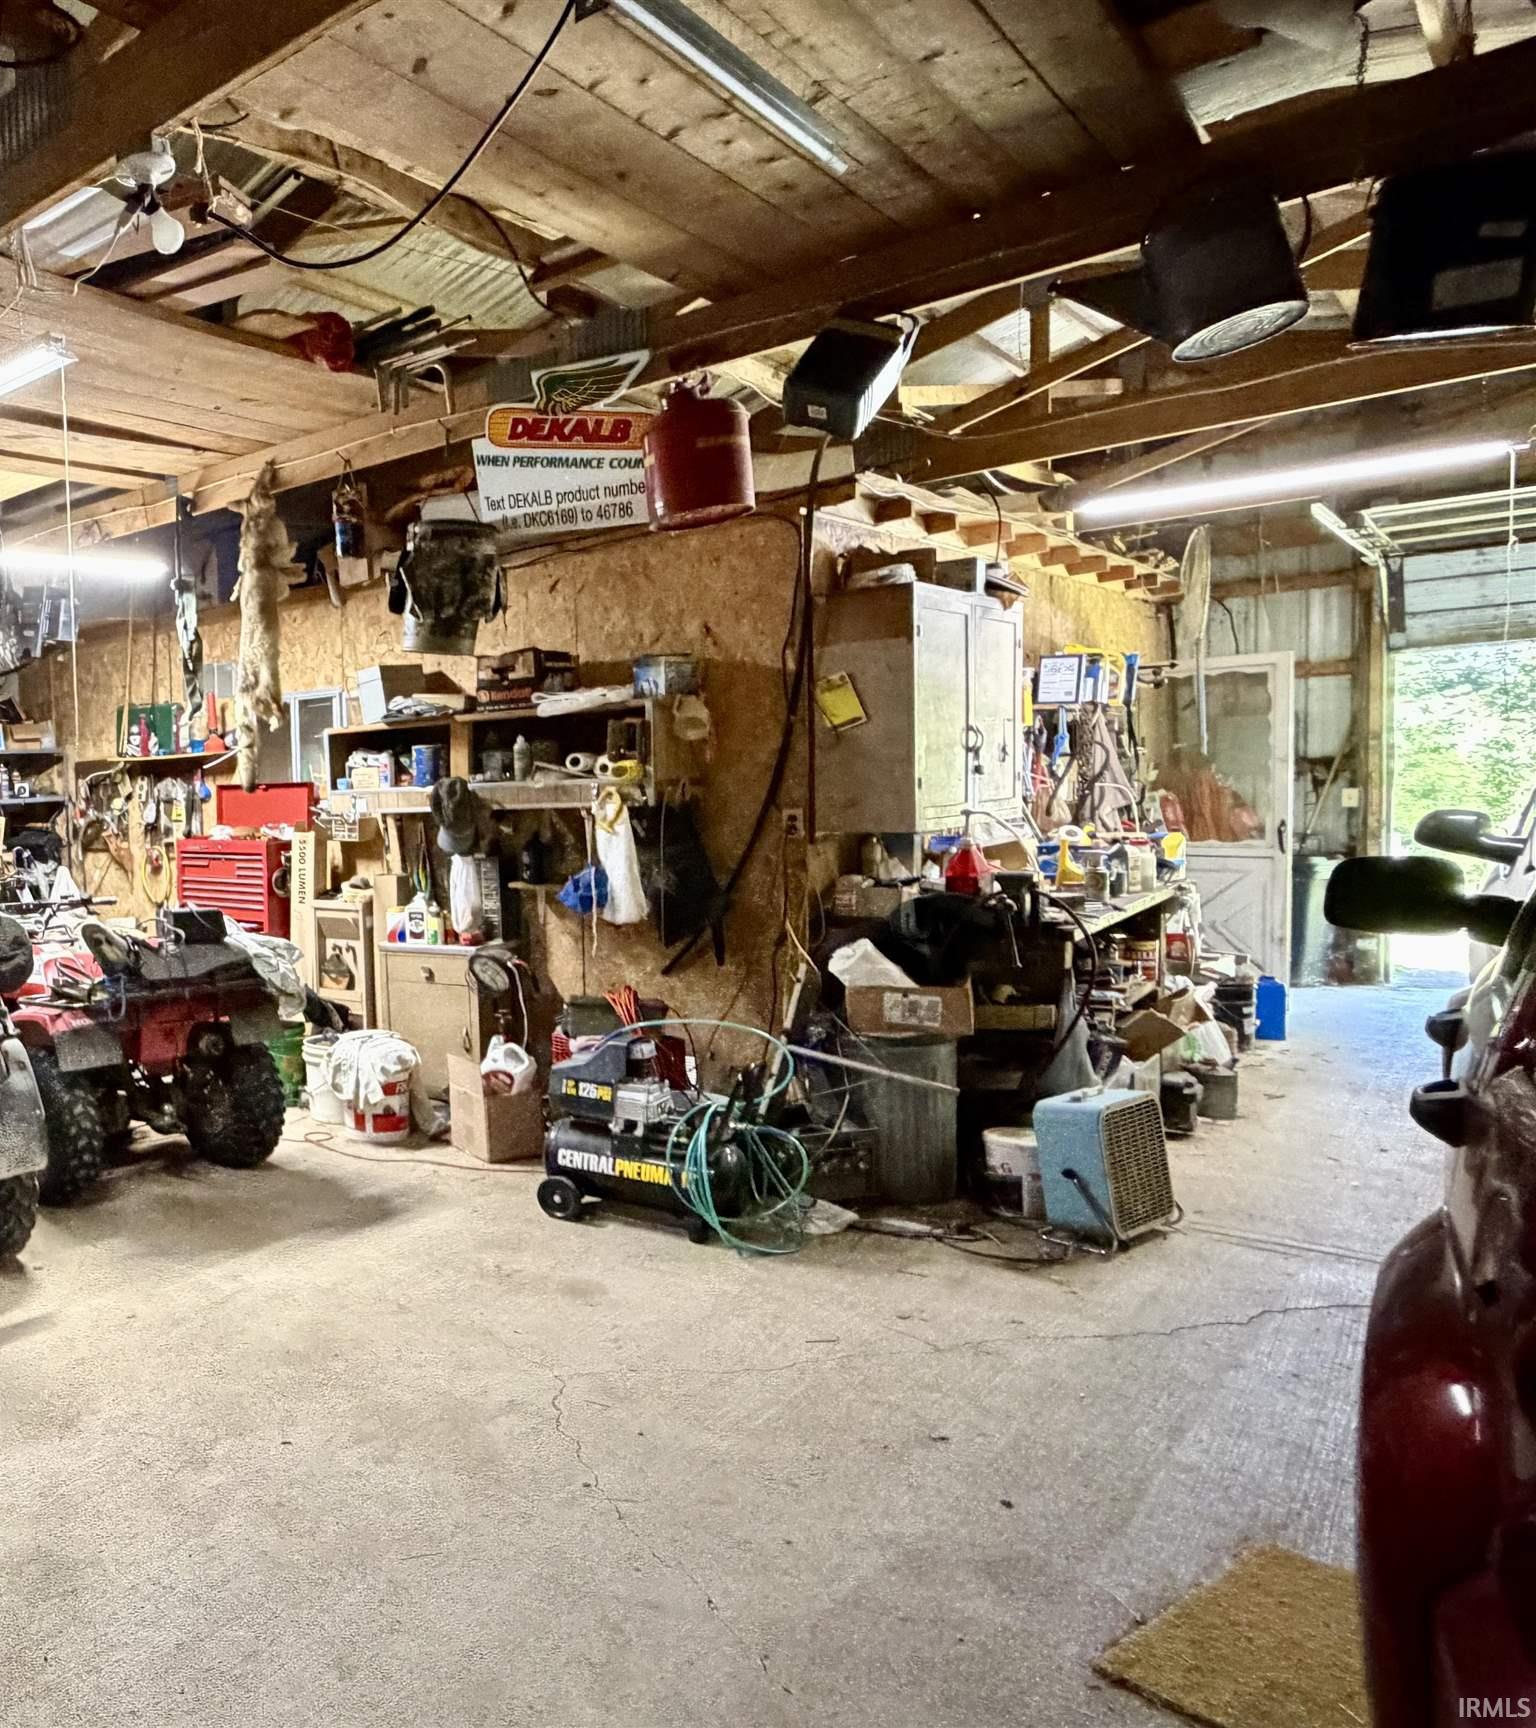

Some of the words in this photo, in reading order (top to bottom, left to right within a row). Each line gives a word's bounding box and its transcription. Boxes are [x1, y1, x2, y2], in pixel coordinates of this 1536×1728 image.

[508, 417, 632, 443] DEKALB
[476, 455, 510, 467] WHEN
[513, 456, 604, 469] PERFORMANCE
[609, 457, 645, 469] COUN
[485, 495, 505, 511] Text
[509, 489, 553, 509] DEKALB
[556, 484, 600, 505] product
[604, 479, 645, 498] numbe
[581, 509, 593, 522] to
[596, 501, 633, 521] 46786
[298, 868, 306, 904] LUMEN
[615, 1158, 687, 1188] PNEUMA
